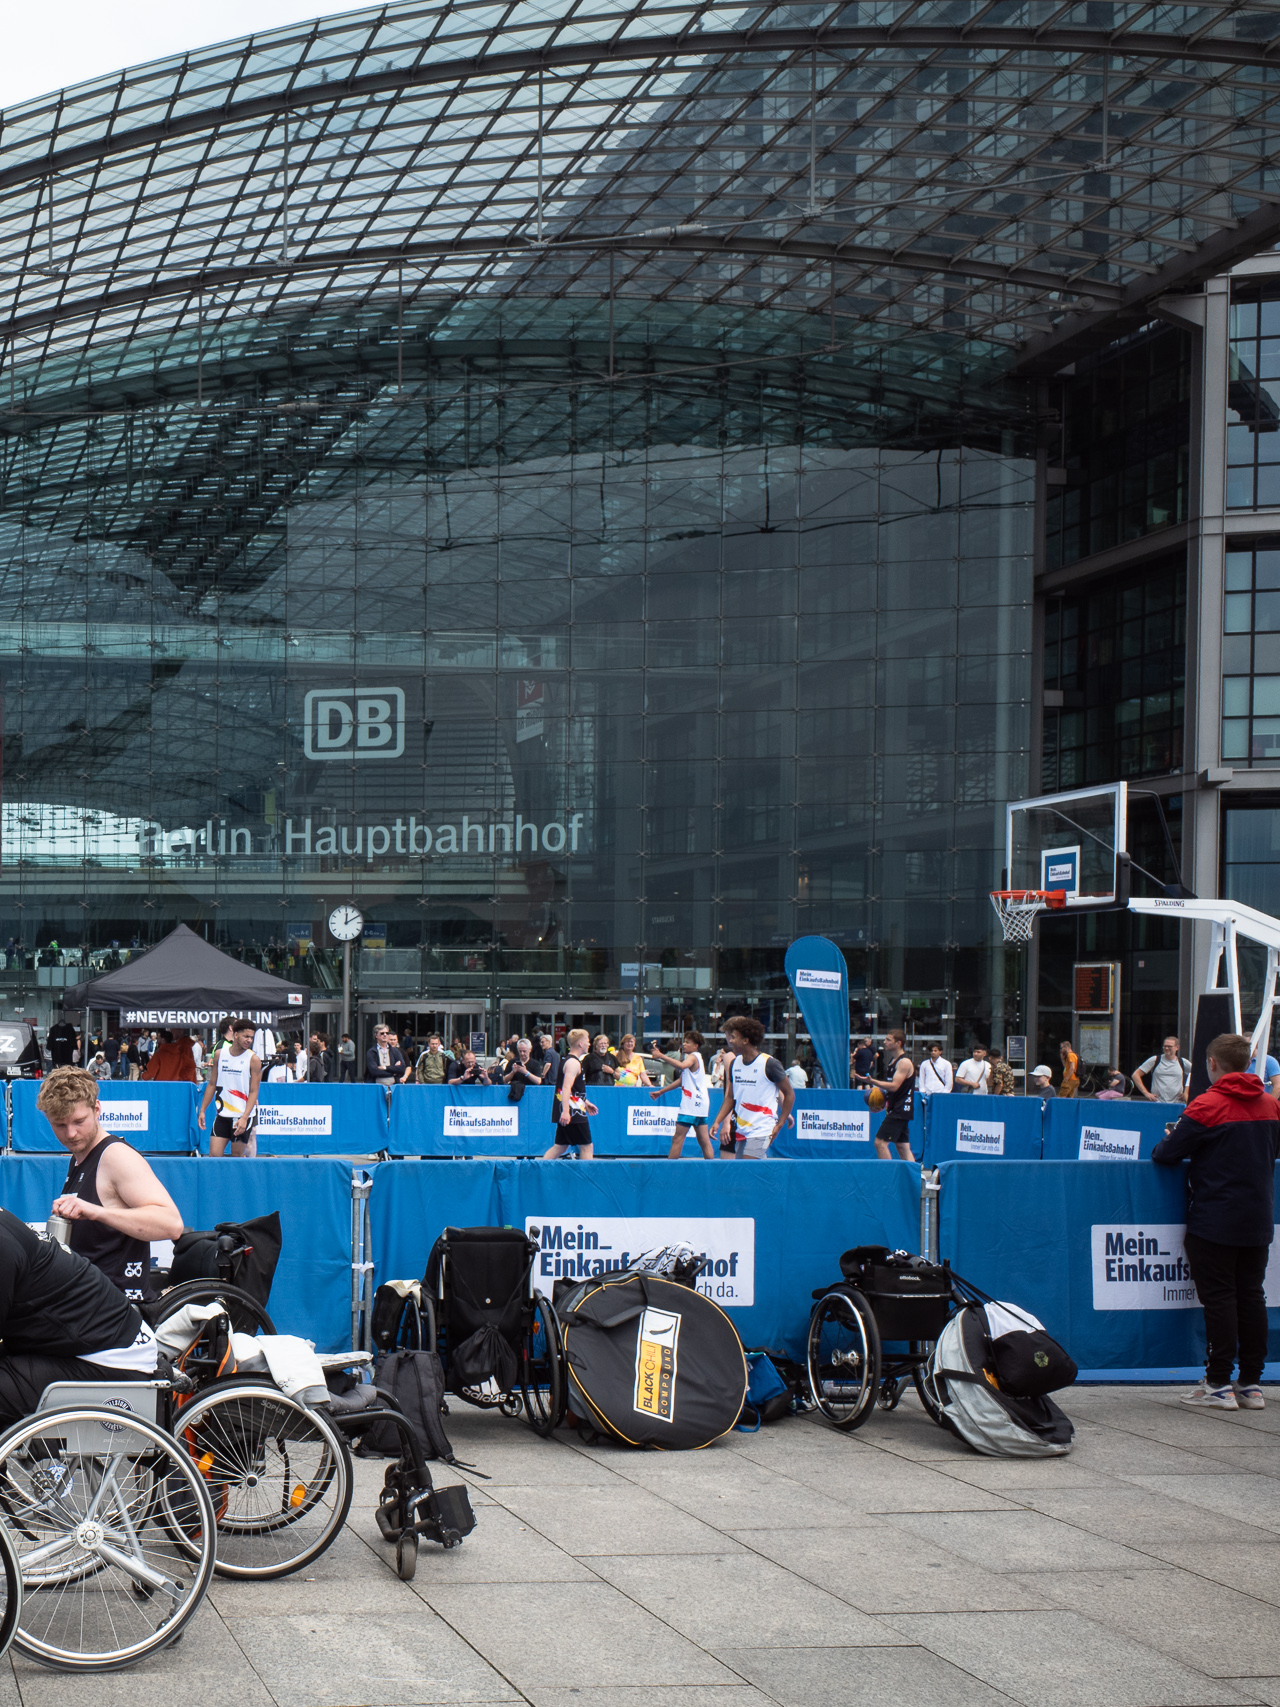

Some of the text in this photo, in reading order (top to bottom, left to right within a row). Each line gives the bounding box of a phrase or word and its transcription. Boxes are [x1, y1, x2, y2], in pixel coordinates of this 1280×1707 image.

[317, 699, 393, 748] DB
[138, 813, 584, 863] Berlin Hauptbahnhof
[99, 1112, 143, 1122] ufsBahnhof
[260, 1116, 326, 1125] EinkaufsBahnhof
[449, 1118, 513, 1127] EinkaufsBahnhof
[801, 1121, 864, 1131] EinkaufsBahnhof
[1083, 1140, 1135, 1156] EinkaufsBahnhof
[540, 1251, 739, 1277] Einkaufhof
[1105, 1257, 1192, 1282] Einkaufs
[696, 1281, 738, 1298] ch da.
[1163, 1286, 1195, 1301] Immer
[643, 1371, 654, 1409] BLACK
[661, 1348, 671, 1415] COMPOUND
[461, 1386, 508, 1403] adidas
[260, 1399, 287, 1416] SOPUR
